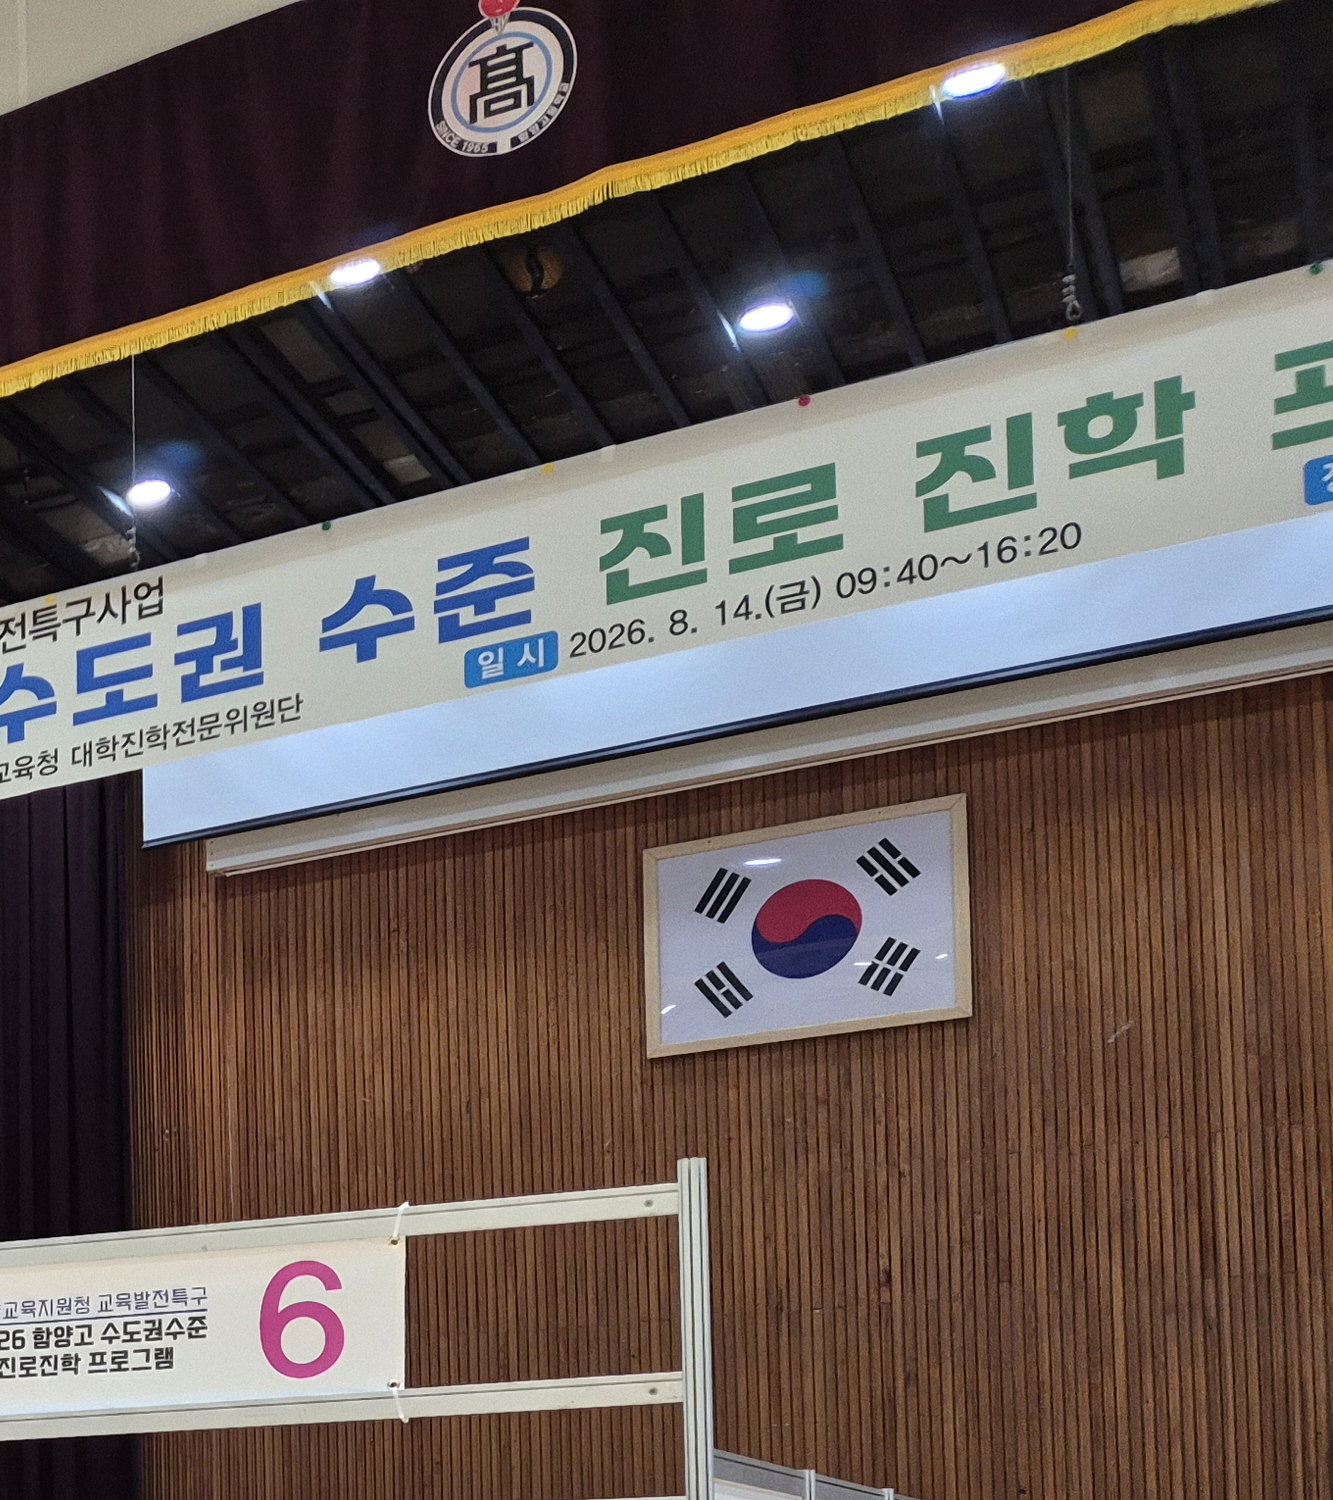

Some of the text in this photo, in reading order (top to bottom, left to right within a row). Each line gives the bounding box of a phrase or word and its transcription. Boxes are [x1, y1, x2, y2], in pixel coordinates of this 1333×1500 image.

[435, 120, 462, 148] SINCE
[319, 536, 535, 664] 수준
[599, 462, 844, 606] 진로
[915, 375, 1196, 534] 진학
[569, 620, 655, 659] 2026.
[670, 609, 698, 637] 8.
[71, 693, 304, 768] 대학진학전문위원단
[97, 1286, 208, 1313] 교육발전특구
[259, 1260, 345, 1379] 6
[32, 1324, 94, 1350] 함양고
[100, 1316, 208, 1345] 수도권수준
[88, 1346, 174, 1374] 프로그램
